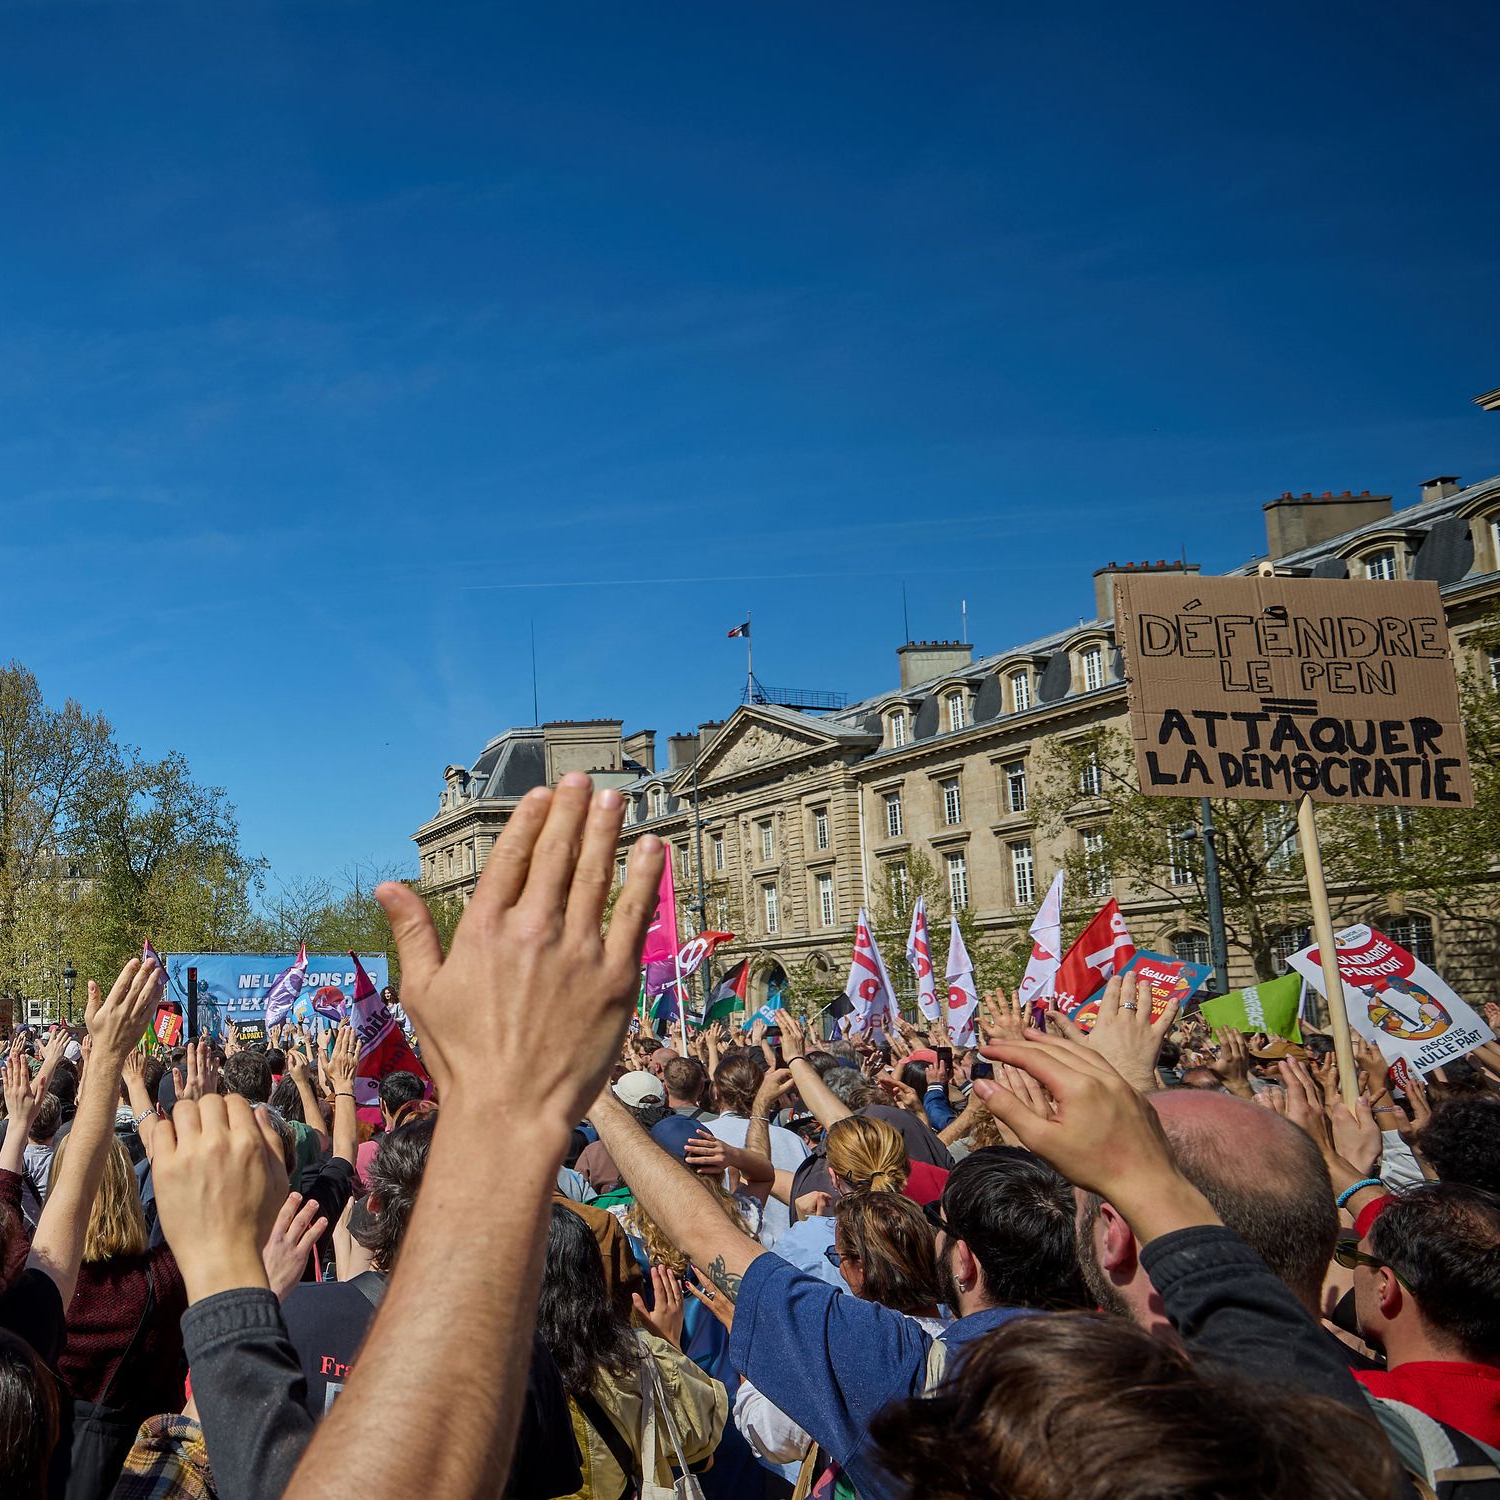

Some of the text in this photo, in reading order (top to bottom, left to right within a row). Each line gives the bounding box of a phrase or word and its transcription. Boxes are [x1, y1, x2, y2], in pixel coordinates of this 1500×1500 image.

[1138, 598, 1448, 659] DÉFENDRE
[1219, 660, 1397, 696] LE PEN
[1158, 708, 1444, 756] ATTAQUER
[1145, 748, 1215, 786] LA
[238, 974, 261, 989] NE
[344, 972, 377, 986] PS
[1138, 966, 1180, 985] ÉGALITÉ
[1340, 957, 1404, 978] PARTOUT
[242, 1025, 259, 1033] POUR
[1419, 1027, 1467, 1054] FASCISTES
[1413, 1029, 1483, 1070] NULLE PART
